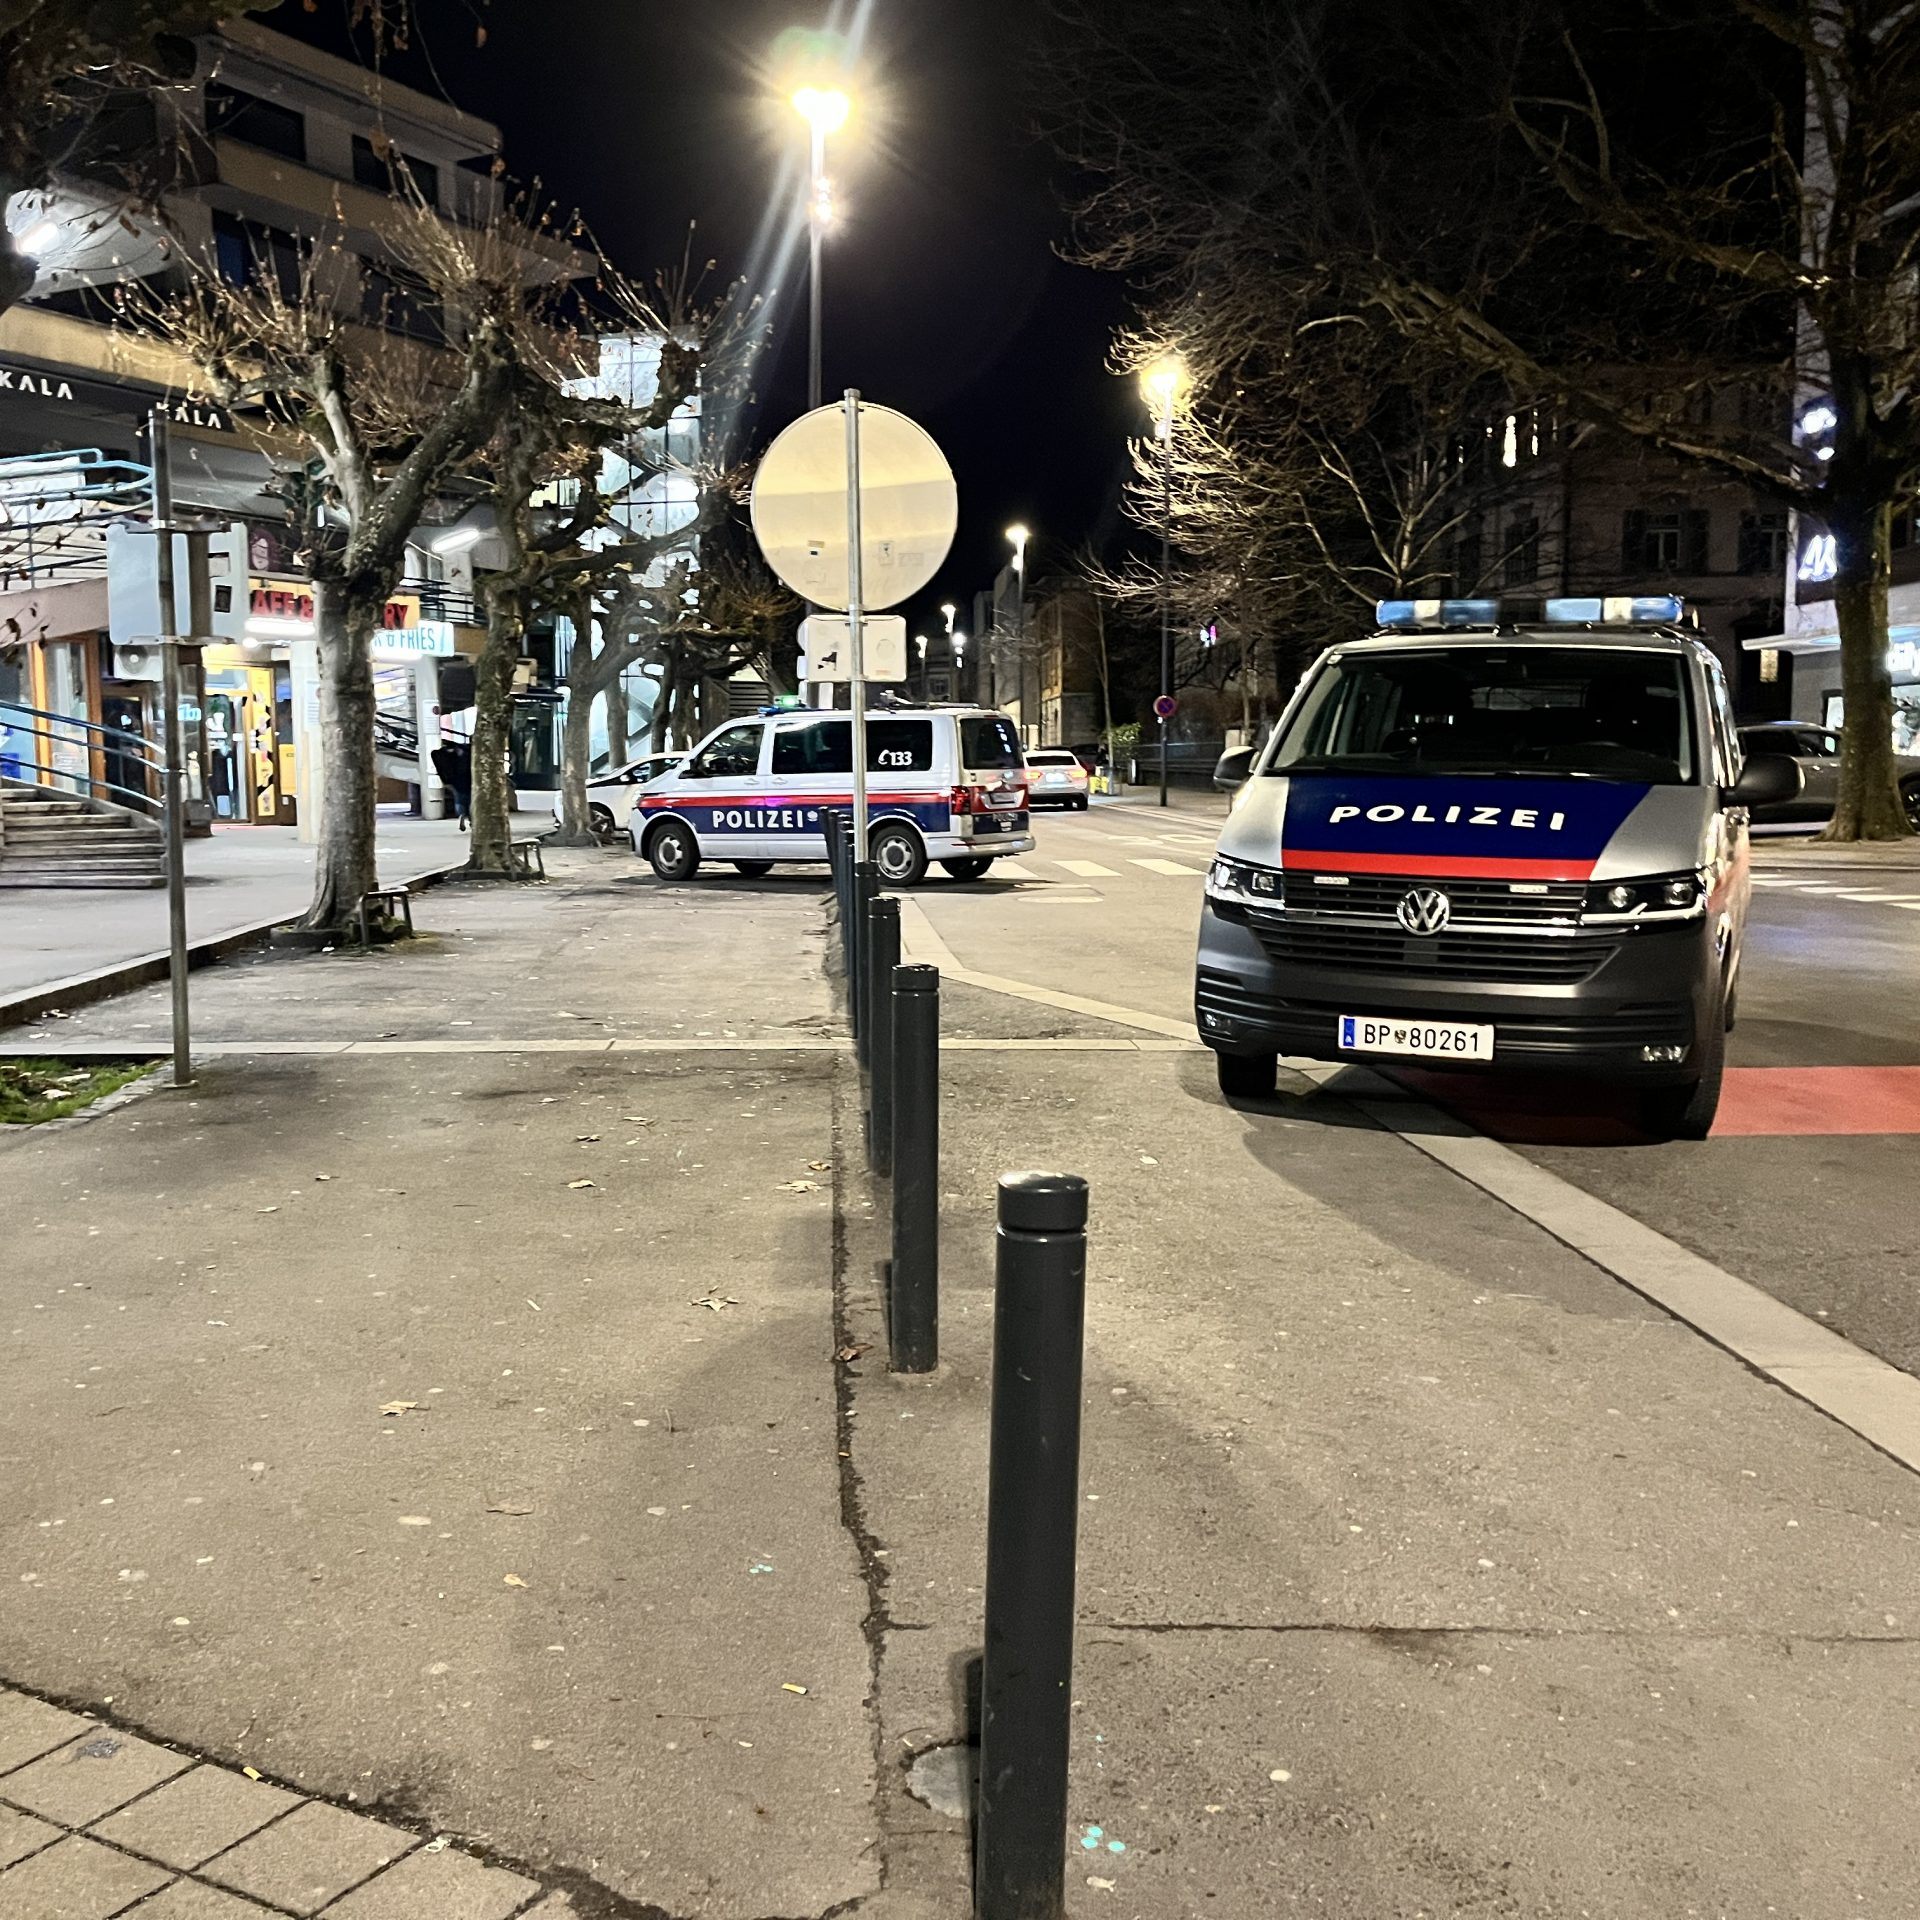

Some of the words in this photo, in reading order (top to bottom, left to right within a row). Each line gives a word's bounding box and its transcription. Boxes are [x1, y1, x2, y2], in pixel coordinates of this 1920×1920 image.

[250, 589, 297, 618] AFE
[890, 751, 913, 766] 133
[712, 810, 804, 829] POLIZEI
[1329, 804, 1565, 831] POLIZEI
[1364, 1023, 1391, 1046] BP
[1409, 1027, 1479, 1052] 80261
